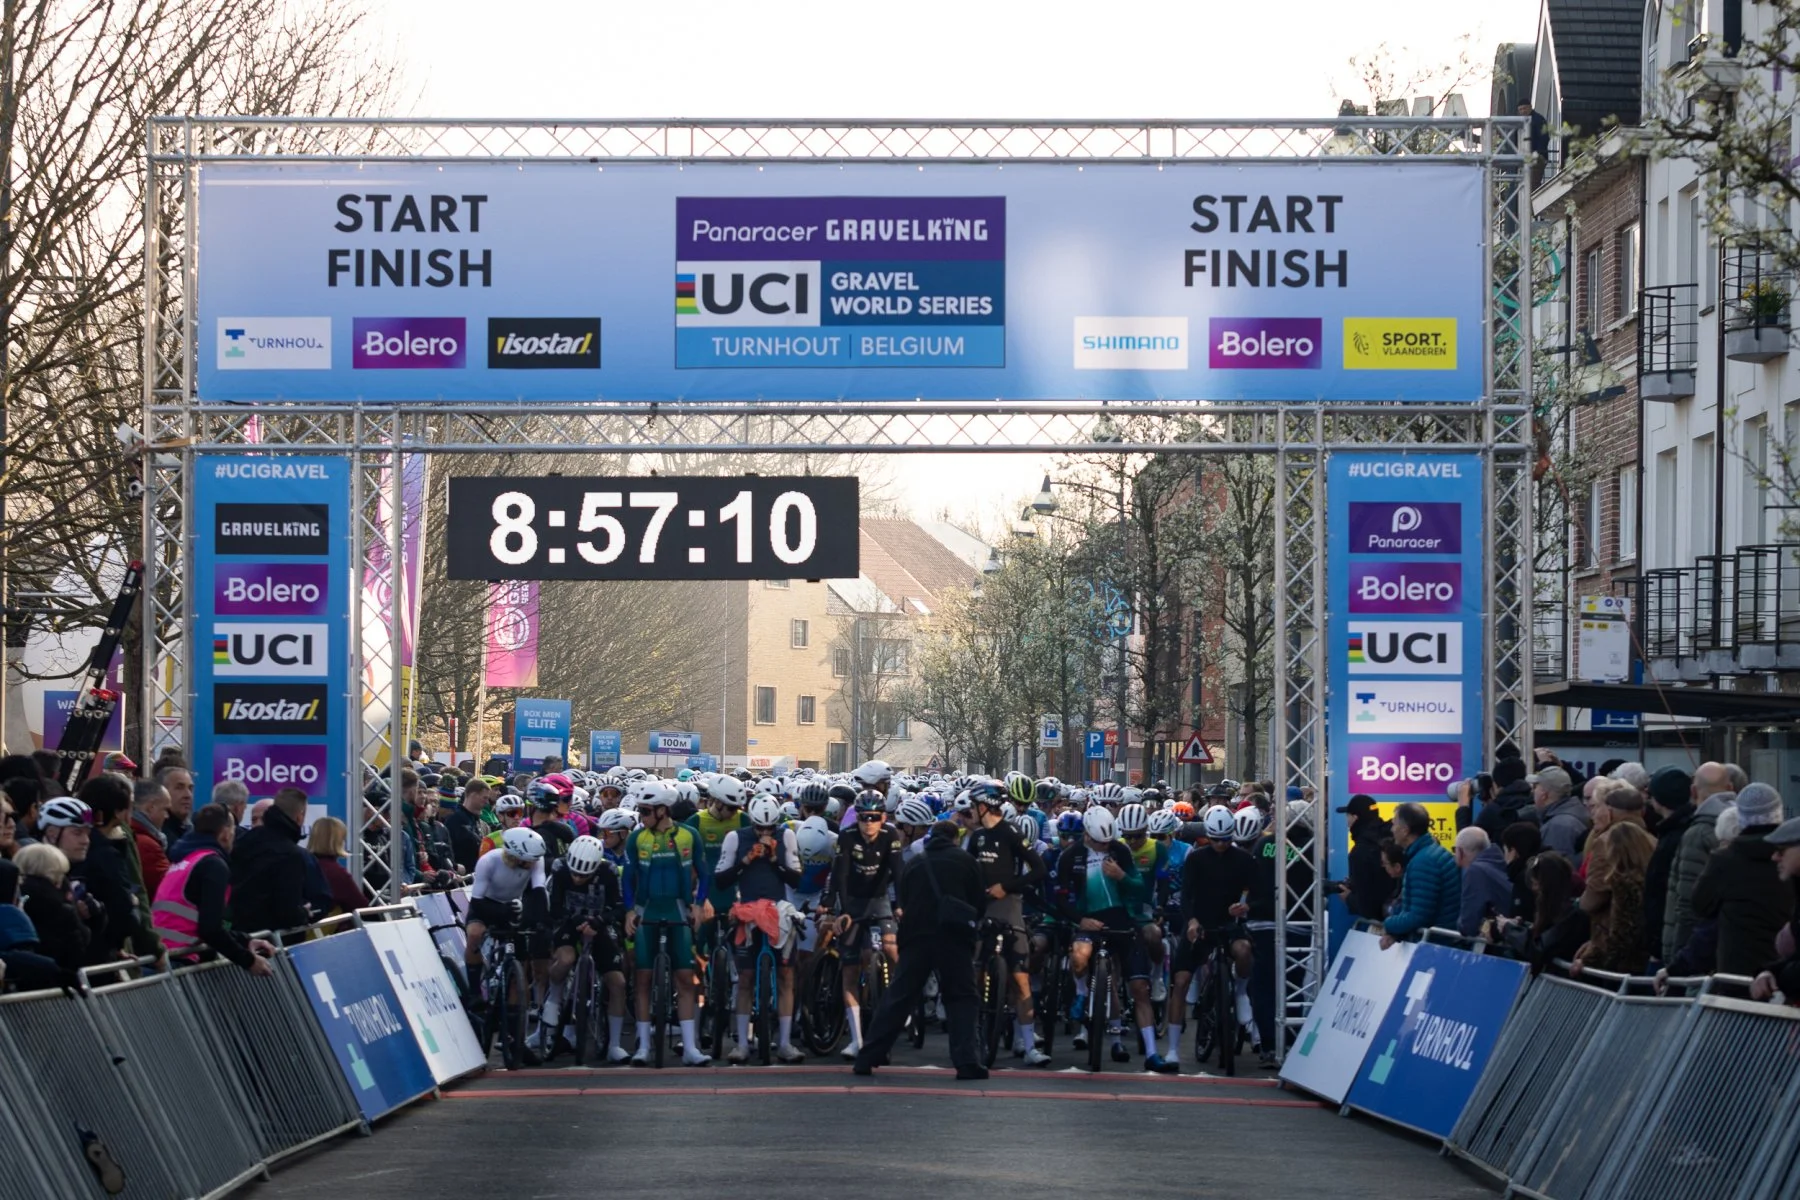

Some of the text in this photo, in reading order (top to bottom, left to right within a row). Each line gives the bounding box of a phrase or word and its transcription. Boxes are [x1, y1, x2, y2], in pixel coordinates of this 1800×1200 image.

[334, 193, 489, 234] START
[1190, 194, 1344, 234] START
[692, 216, 989, 243] Panaracer GRAVELKING
[327, 248, 493, 288] FINISH
[1184, 248, 1348, 288] FINISH
[701, 272, 809, 316] UCI
[830, 272, 920, 291] GRAVEL
[830, 296, 993, 316] WORLD SERIES
[361, 329, 458, 357] Bolero
[497, 333, 592, 357] isostar
[711, 336, 965, 357] TURNHOUT BELGIUM
[1083, 335, 1180, 351] SHIMANO
[1217, 330, 1314, 357] Bolero
[1382, 346, 1447, 357] VLAANDEREN
[1383, 331, 1448, 347] SPORT.
[215, 463, 330, 480] #UCIGRAVEL
[1348, 462, 1462, 479] #UCIGRAVEL
[221, 521, 321, 537] GRAVELKING
[489, 490, 817, 566] 8:57:10
[1368, 534, 1442, 550] Panaracer
[223, 577, 320, 603] Bolero
[1357, 575, 1454, 602] Bolero
[233, 633, 313, 666] UCI
[1367, 632, 1448, 665] UCI
[222, 698, 319, 722] isostar
[523, 710, 561, 719] BOX MEN
[527, 719, 557, 729] ELITE
[1089, 732, 1101, 748] P
[222, 757, 319, 784] Bolero
[1357, 755, 1454, 782] Bolero
